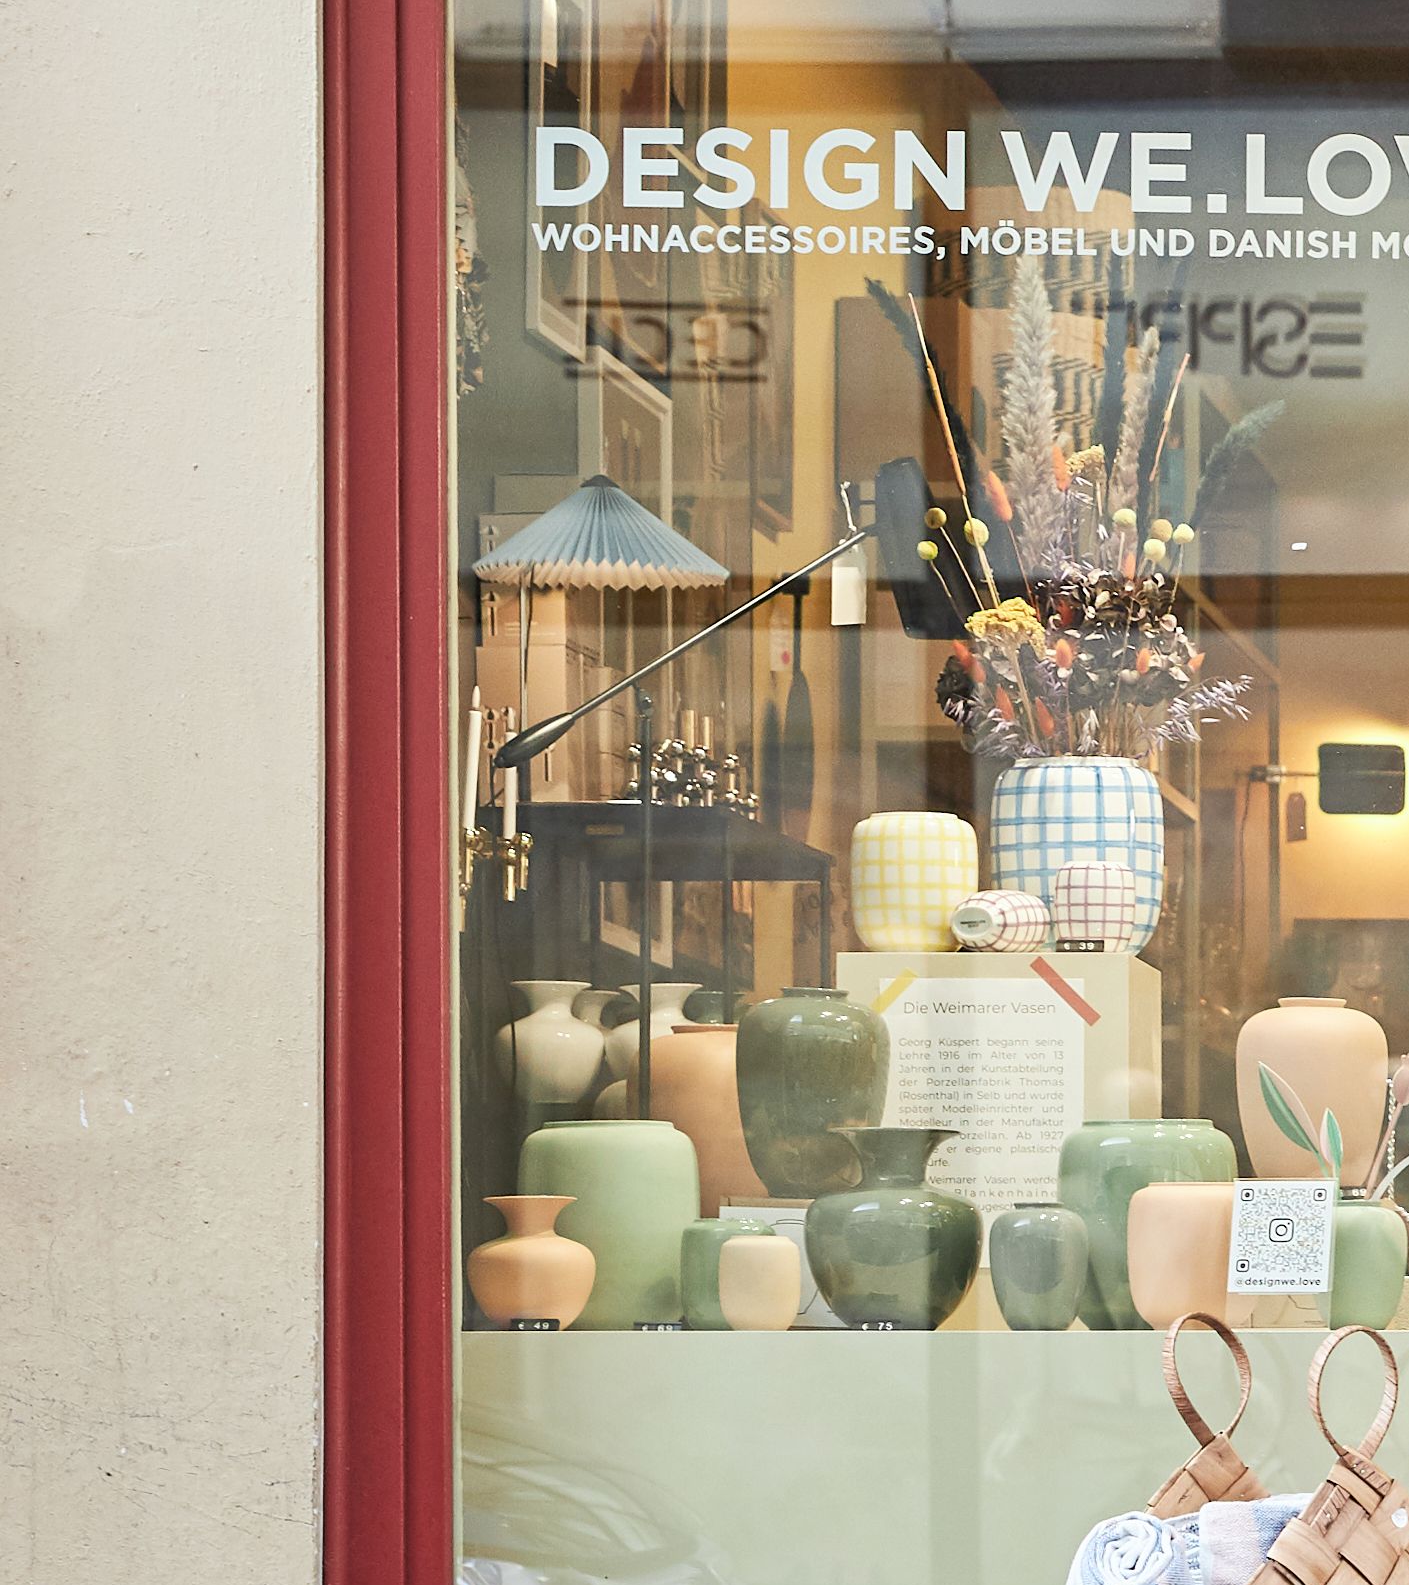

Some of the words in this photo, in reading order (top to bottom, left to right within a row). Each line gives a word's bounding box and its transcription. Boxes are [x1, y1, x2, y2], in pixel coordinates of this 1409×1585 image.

[536, 126, 966, 211] DESIGN
[531, 222, 946, 261] WOHNACCESSOIRES,
[960, 219, 1097, 257] MÖBEL
[1111, 227, 1195, 259] UND
[1209, 228, 1356, 260] DANISH
[903, 1002, 928, 1014] Die
[932, 1002, 1006, 1014] Weimarer
[1011, 1002, 1056, 1014] Vasen
[899, 1038, 932, 1048] Georg
[938, 1037, 980, 1048] Küspert
[987, 1038, 1029, 1048] begann
[1036, 1039, 1064, 1047] seine
[899, 1050, 931, 1060] Lehre
[938, 1050, 960, 1060] 1916
[968, 1050, 982, 1060] im
[990, 1050, 1017, 1060] Alter
[1025, 1052, 1046, 1060] von
[1054, 1050, 1064, 1060] 13
[898, 1064, 936, 1074] Jahren
[942, 1064, 951, 1074] in
[957, 1064, 974, 1074] der
[981, 1064, 1064, 1075] Kunstabteilung
[899, 1077, 917, 1087] der
[926, 1077, 1011, 1087] Porzellanfabrik
[1019, 1077, 1064, 1087] Thomas
[899, 1091, 960, 1102] (Rosenthal)
[963, 1091, 973, 1100] in
[976, 1091, 1000, 1100] Selb
[1004, 1091, 1026, 1100] und
[1030, 1091, 1064, 1100] wurde
[899, 1104, 934, 1115] später
[942, 1104, 1033, 1113] Modelleinrichter
[1042, 1104, 1064, 1113] und
[899, 1117, 952, 1127] Modelleur
[959, 1117, 969, 1126] in
[976, 1117, 993, 1126] der
[1001, 1117, 1064, 1126] Manufaktur
[959, 1131, 1008, 1141] orzellan.
[1016, 1131, 1032, 1140] Ab
[1040, 1131, 1064, 1140] 1927
[946, 1146, 957, 1154] er
[965, 1145, 1003, 1155] eigene
[984, 1176, 1016, 1184] Vasen
[1235, 1276, 1321, 1288] @designwe.love
[534, 1322, 550, 1330] 49
